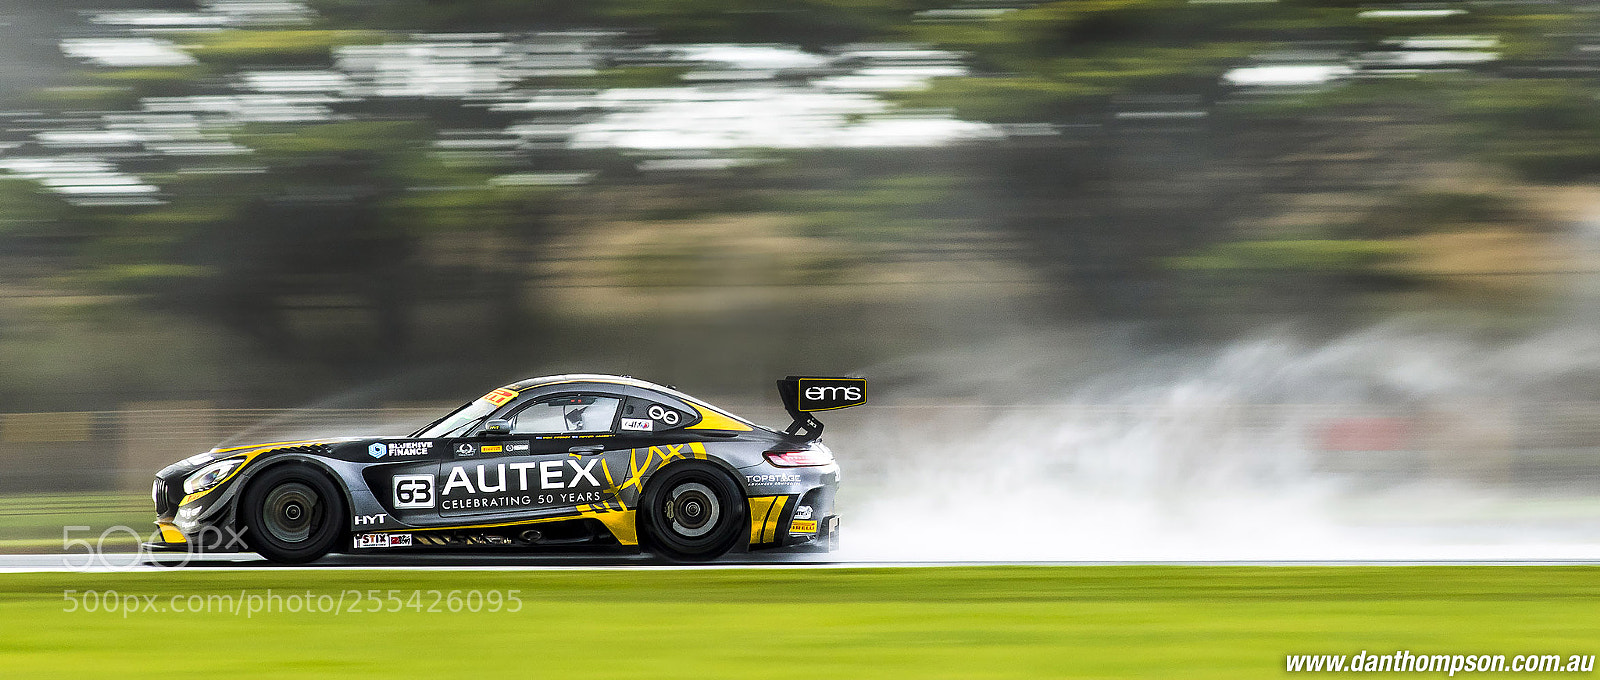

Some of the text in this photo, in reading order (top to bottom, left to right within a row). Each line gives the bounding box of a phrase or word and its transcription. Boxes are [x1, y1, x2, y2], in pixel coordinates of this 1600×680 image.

[805, 386, 862, 401] ems
[389, 448, 428, 456] FINANCE
[441, 458, 601, 496] AUTEX
[396, 479, 431, 504] 63
[442, 491, 601, 510] CELEBRATING 50 YEARS
[354, 513, 388, 525] HYT
